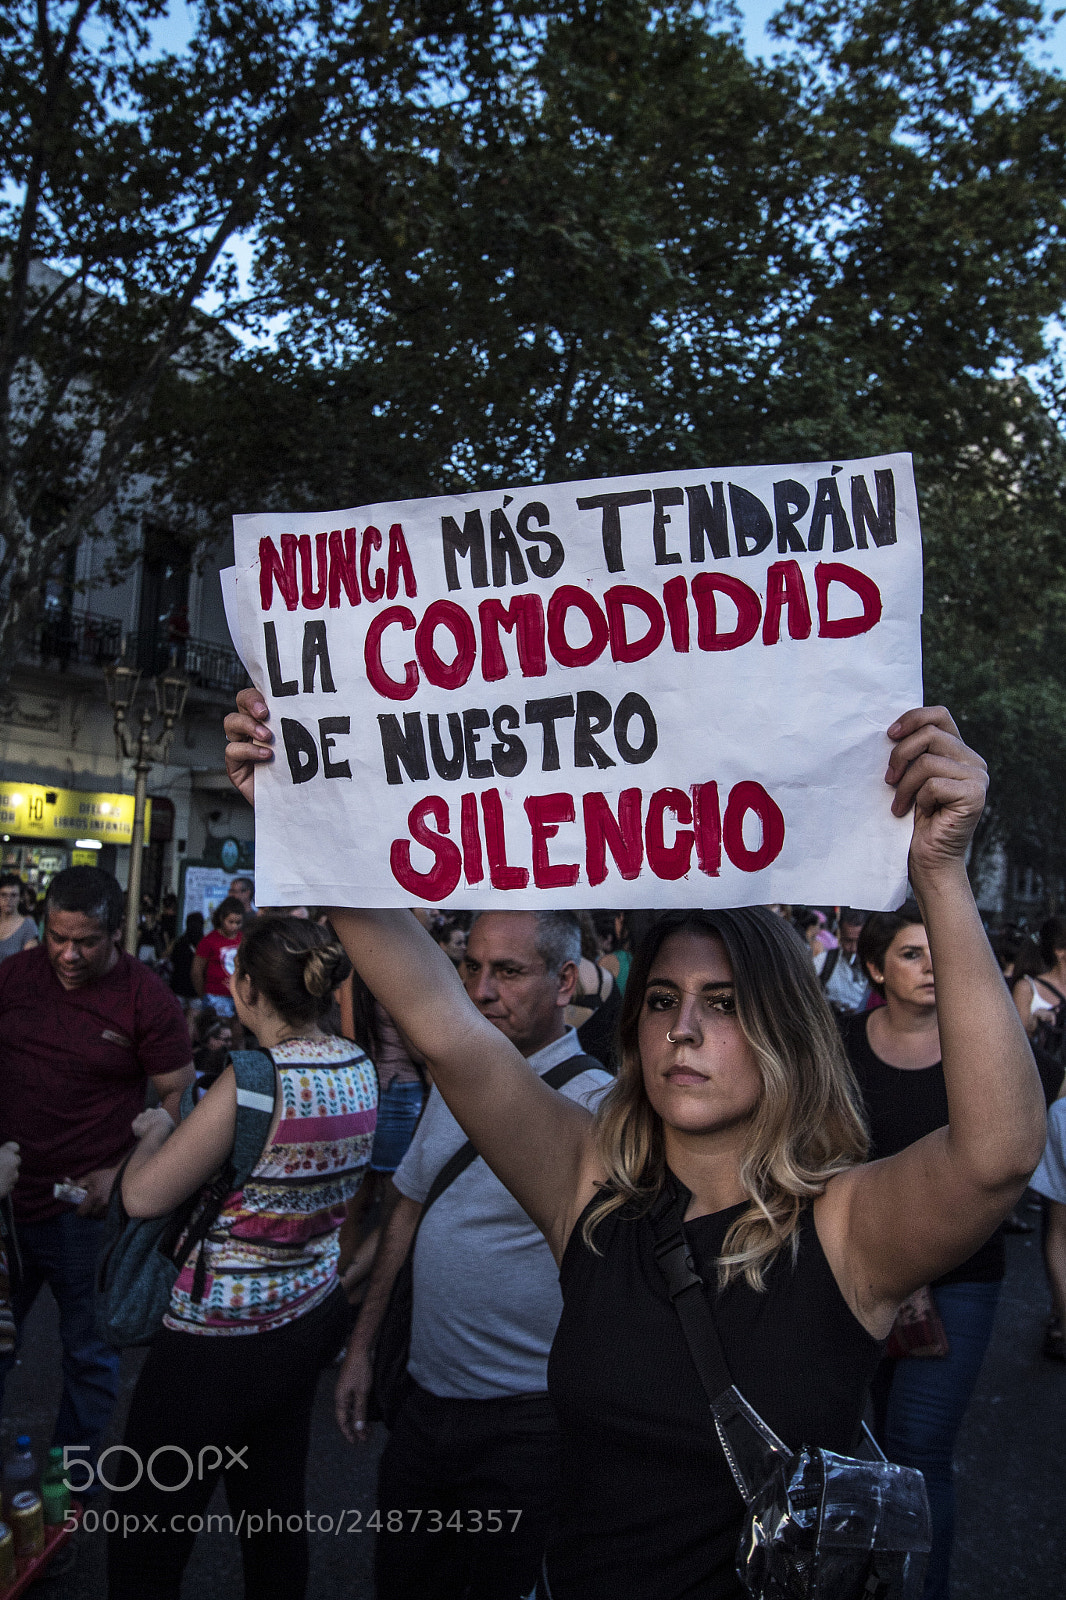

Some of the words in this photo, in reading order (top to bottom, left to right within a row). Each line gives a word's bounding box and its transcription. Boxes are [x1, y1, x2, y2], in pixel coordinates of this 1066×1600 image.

[258, 523, 417, 611] NUNCA
[440, 495, 564, 591] MÁS
[576, 465, 897, 573] TENDRÁN
[263, 620, 336, 697] LA
[364, 560, 883, 701] COMODIDAD
[280, 716, 352, 784] DE
[377, 690, 658, 785] NUESTRO
[390, 780, 785, 902] SILENCIO
